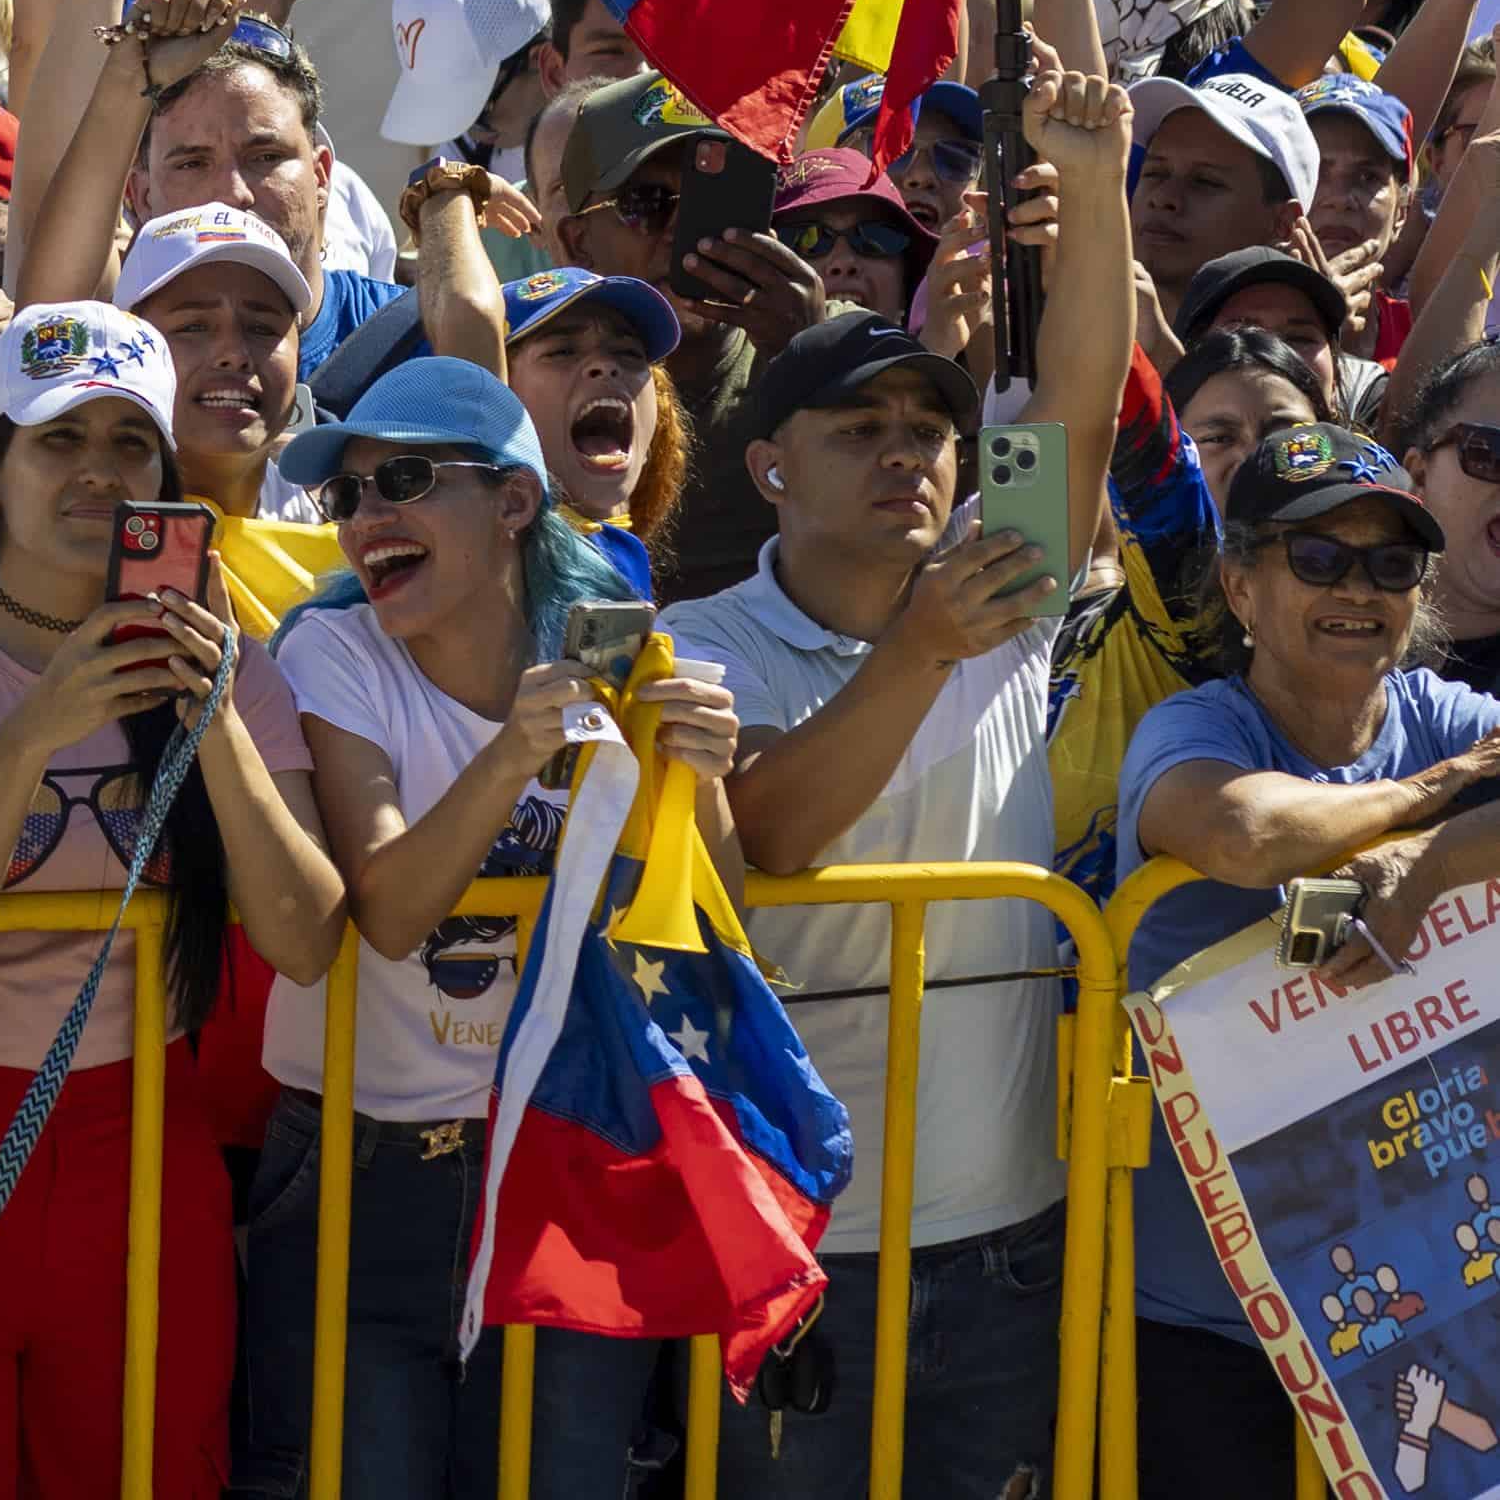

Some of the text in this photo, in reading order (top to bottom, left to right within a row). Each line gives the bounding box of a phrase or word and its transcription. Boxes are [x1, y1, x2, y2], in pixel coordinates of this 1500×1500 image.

[214, 211, 232, 225] EL
[1347, 979, 1480, 1073] LIBRE
[1381, 1063, 1490, 1132] Gloria
[1367, 1101, 1475, 1170] bravo
